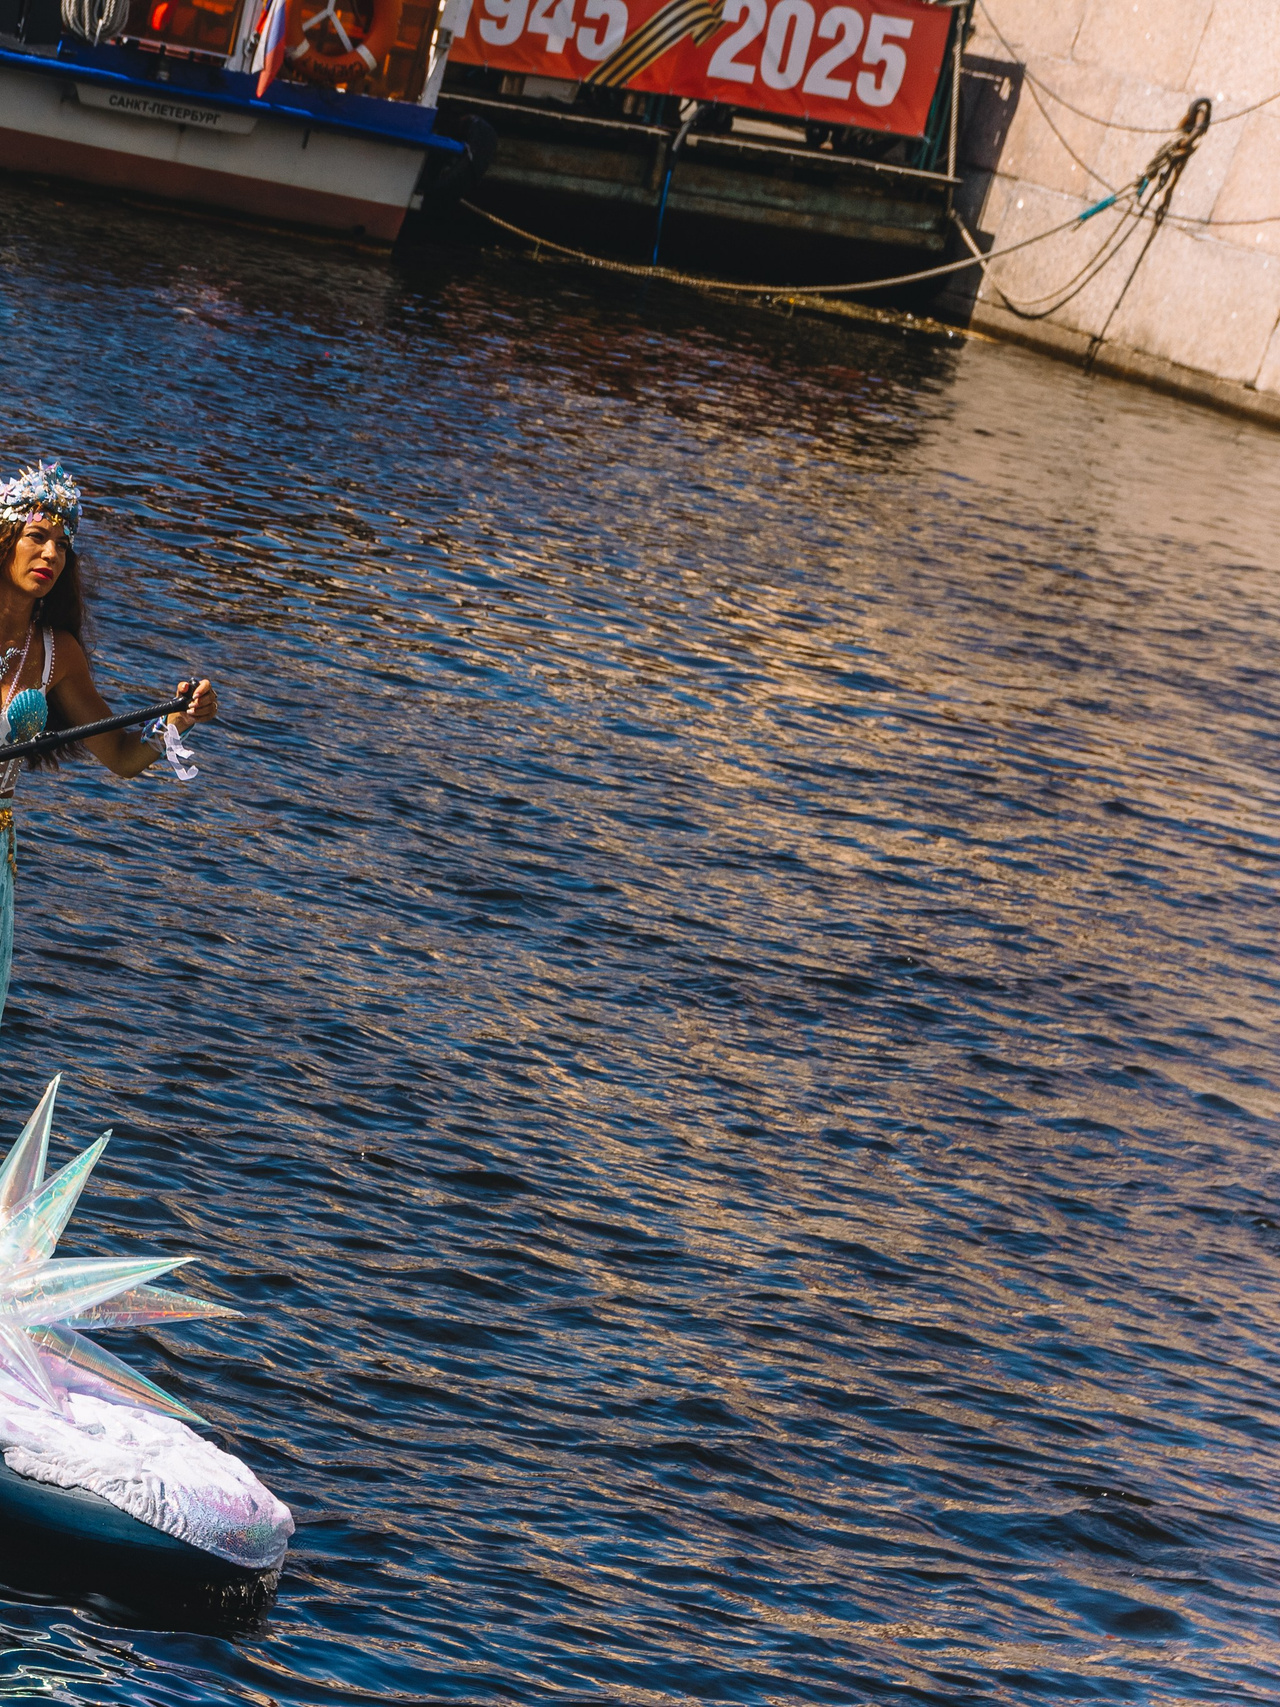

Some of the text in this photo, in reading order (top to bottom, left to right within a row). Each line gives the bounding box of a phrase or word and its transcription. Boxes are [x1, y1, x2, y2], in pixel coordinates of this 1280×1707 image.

[452, 0, 914, 107] 945 2025
[108, 94, 221, 125] САНКТ-ПЕТЕРБУРГ
